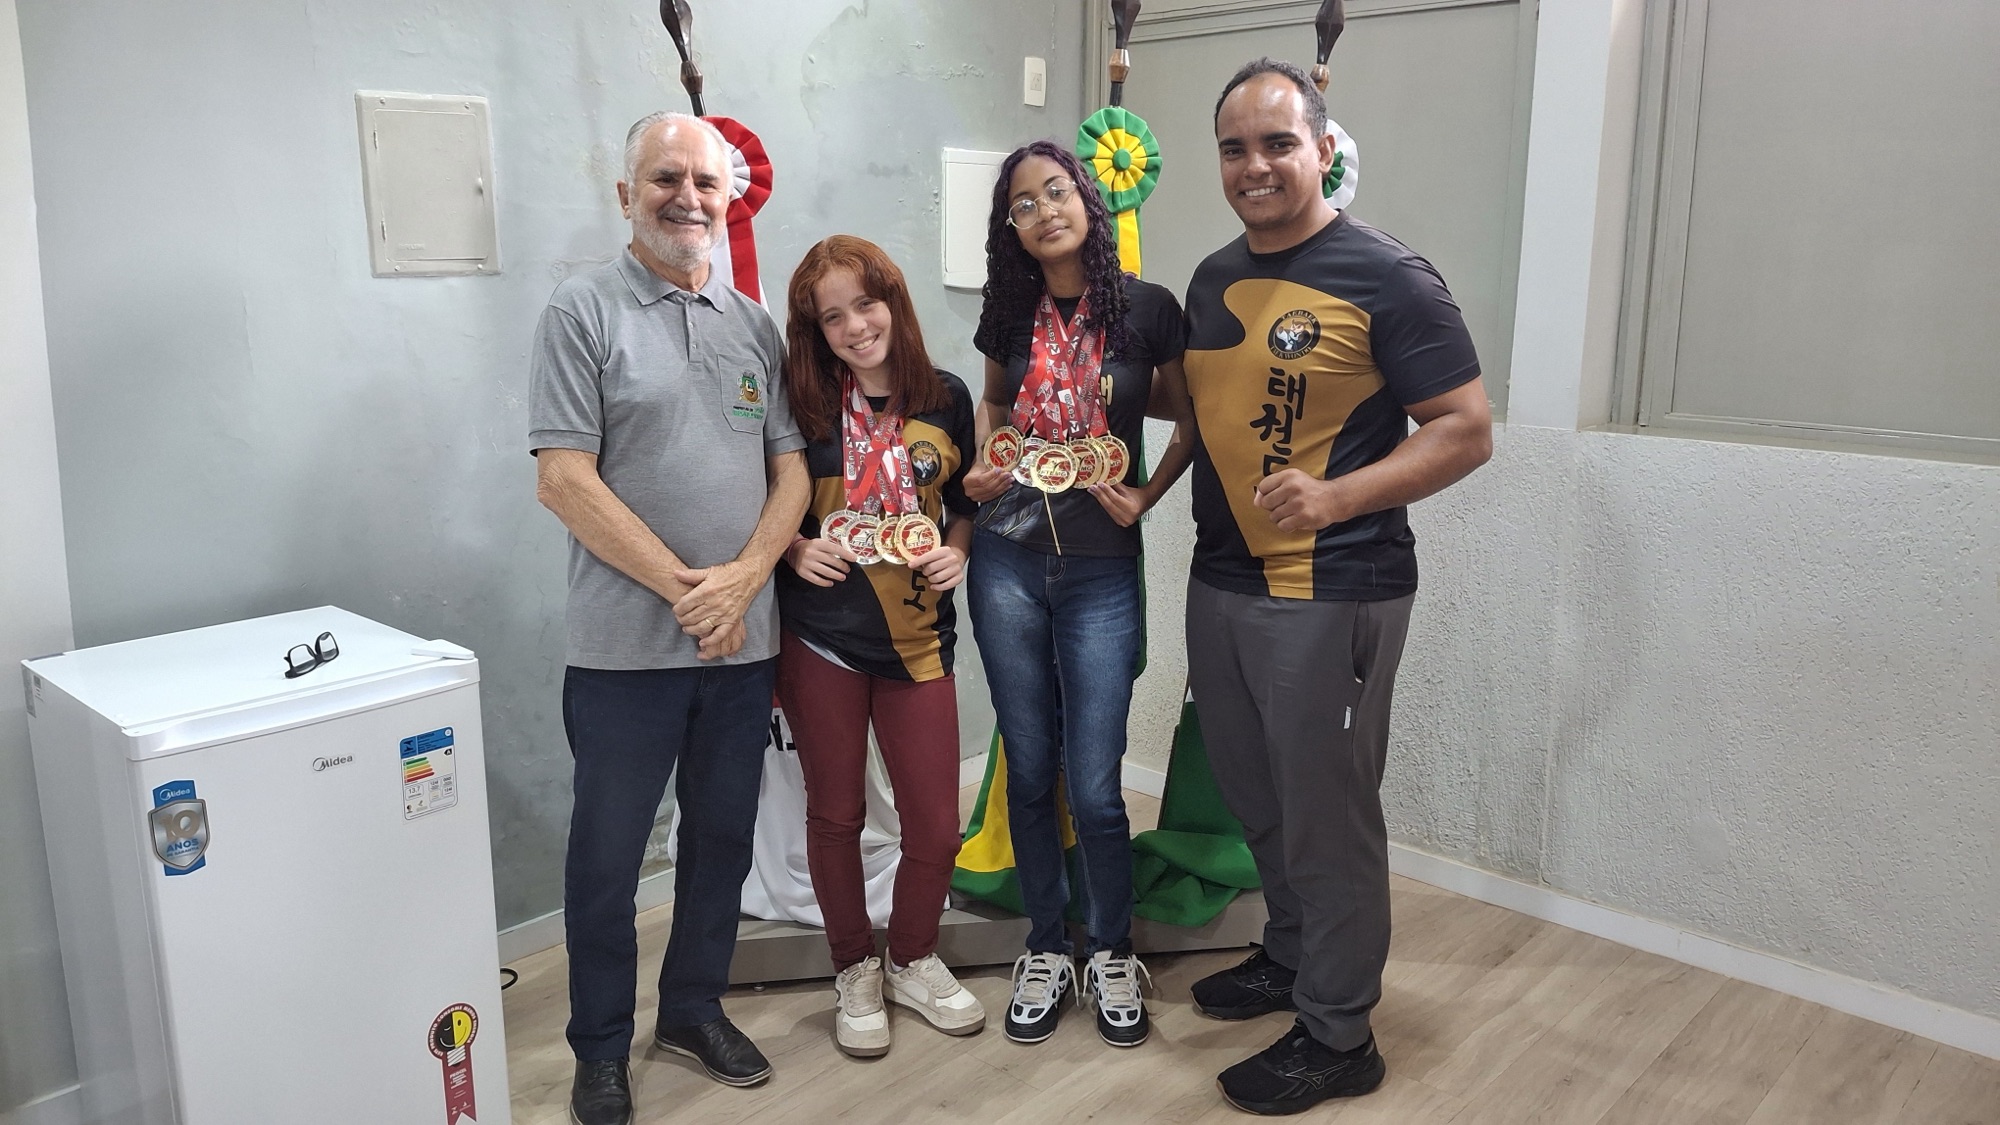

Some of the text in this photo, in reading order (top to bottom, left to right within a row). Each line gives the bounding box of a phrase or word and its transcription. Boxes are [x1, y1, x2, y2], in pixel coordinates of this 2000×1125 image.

[1047, 318, 1056, 341] CBTKD
[1077, 350, 1086, 365] 2026
[1052, 428, 1060, 442] TKD
[313, 757, 353, 772] Midea
[160, 789, 190, 801] Midea
[160, 810, 200, 843] 10
[166, 839, 199, 853] ANOS
[429, 1023, 438, 1050] PRODUTO
[437, 1004, 463, 1022] CONSOME
[463, 1005, 477, 1020] MENOS
